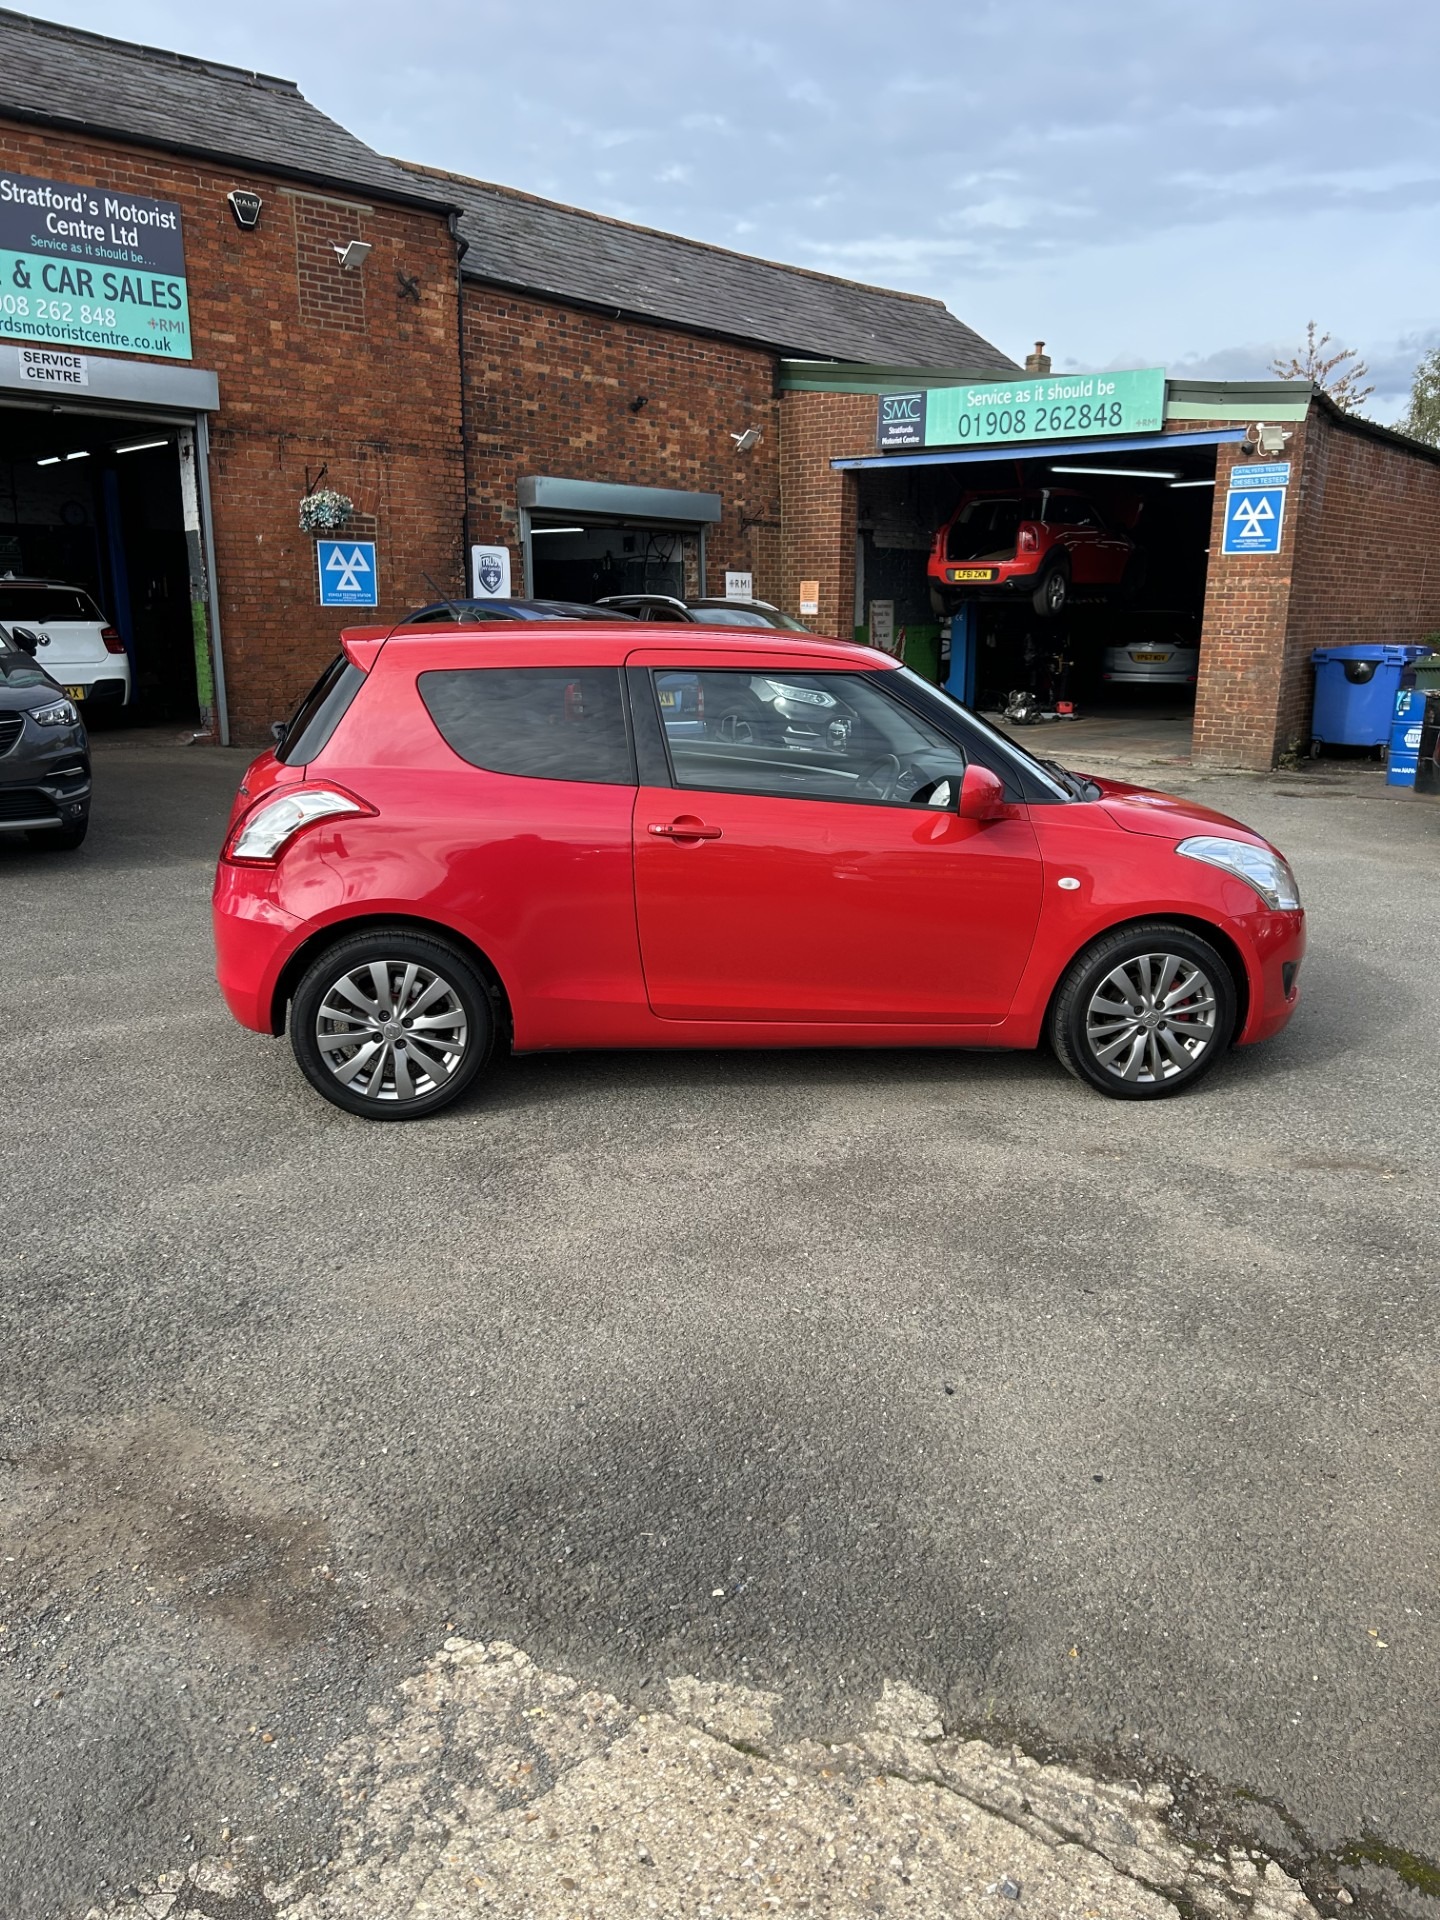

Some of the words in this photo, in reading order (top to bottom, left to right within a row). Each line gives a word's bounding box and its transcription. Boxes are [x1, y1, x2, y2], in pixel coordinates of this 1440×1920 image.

[0, 179, 99, 216] Stratford's
[104, 198, 177, 230] Motorist
[46, 213, 105, 241] Centre
[111, 223, 139, 247] Ltd
[30, 234, 68, 251] Service
[70, 243, 82, 254] as
[85, 243, 92, 256] it
[95, 246, 128, 261] should
[12, 259, 32, 289] &
[42, 263, 95, 298] CAR
[102, 272, 182, 310] SALES
[0, 294, 30, 316] 08
[36, 299, 74, 322] 262
[80, 305, 117, 328] 848
[23, 351, 82, 368] SERVICE
[26, 367, 81, 383] CENTRE
[966, 390, 1012, 407] Service
[1016, 390, 1031, 403] as
[1034, 385, 1043, 401] it
[1047, 381, 1093, 400] should
[1097, 379, 1115, 396] be
[882, 399, 921, 420] SMC
[958, 409, 1026, 438] 01908
[1034, 401, 1122, 432] 262848
[881, 437, 902, 445] Motorist
[903, 435, 920, 444] Centre
[1233, 478, 1259, 486] DIESELS
[1234, 467, 1264, 475] CATALYSTS
